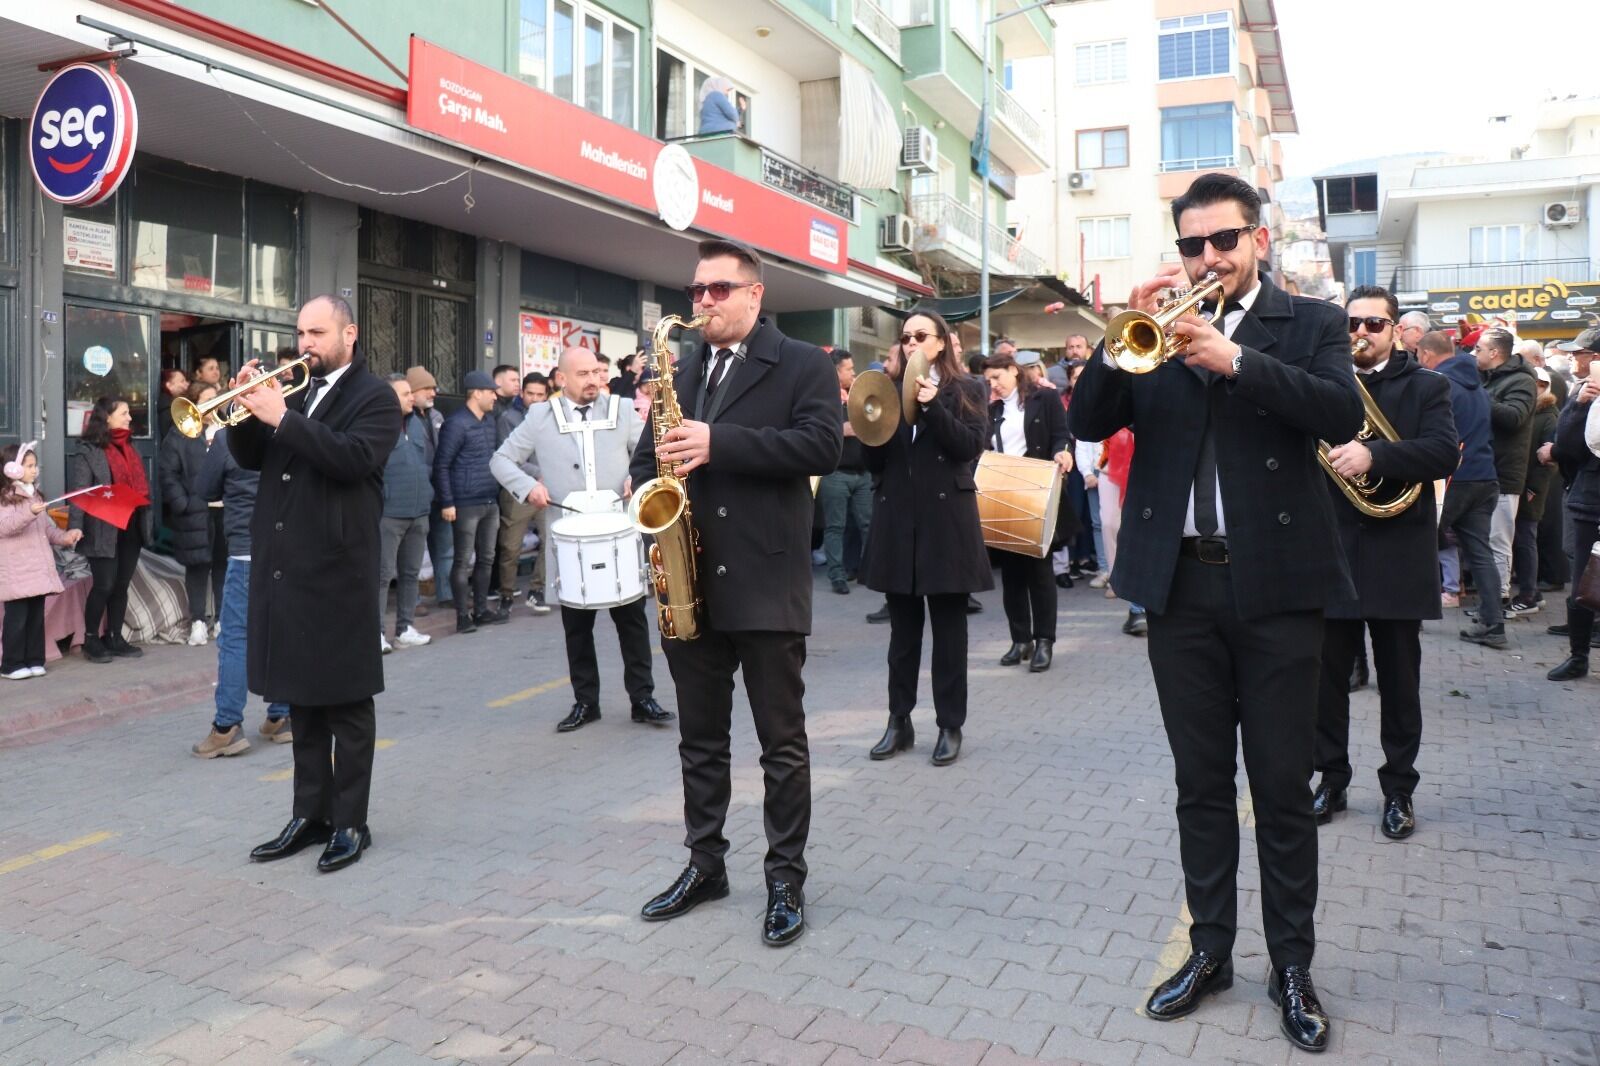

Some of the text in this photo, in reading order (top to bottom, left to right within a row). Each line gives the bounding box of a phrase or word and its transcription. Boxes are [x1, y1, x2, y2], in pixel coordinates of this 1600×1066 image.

[40, 105, 107, 150] seç
[438, 93, 508, 134] Çarşı Mah.
[580, 141, 648, 181] Mahallenizin
[1468, 289, 1551, 309] cadde
